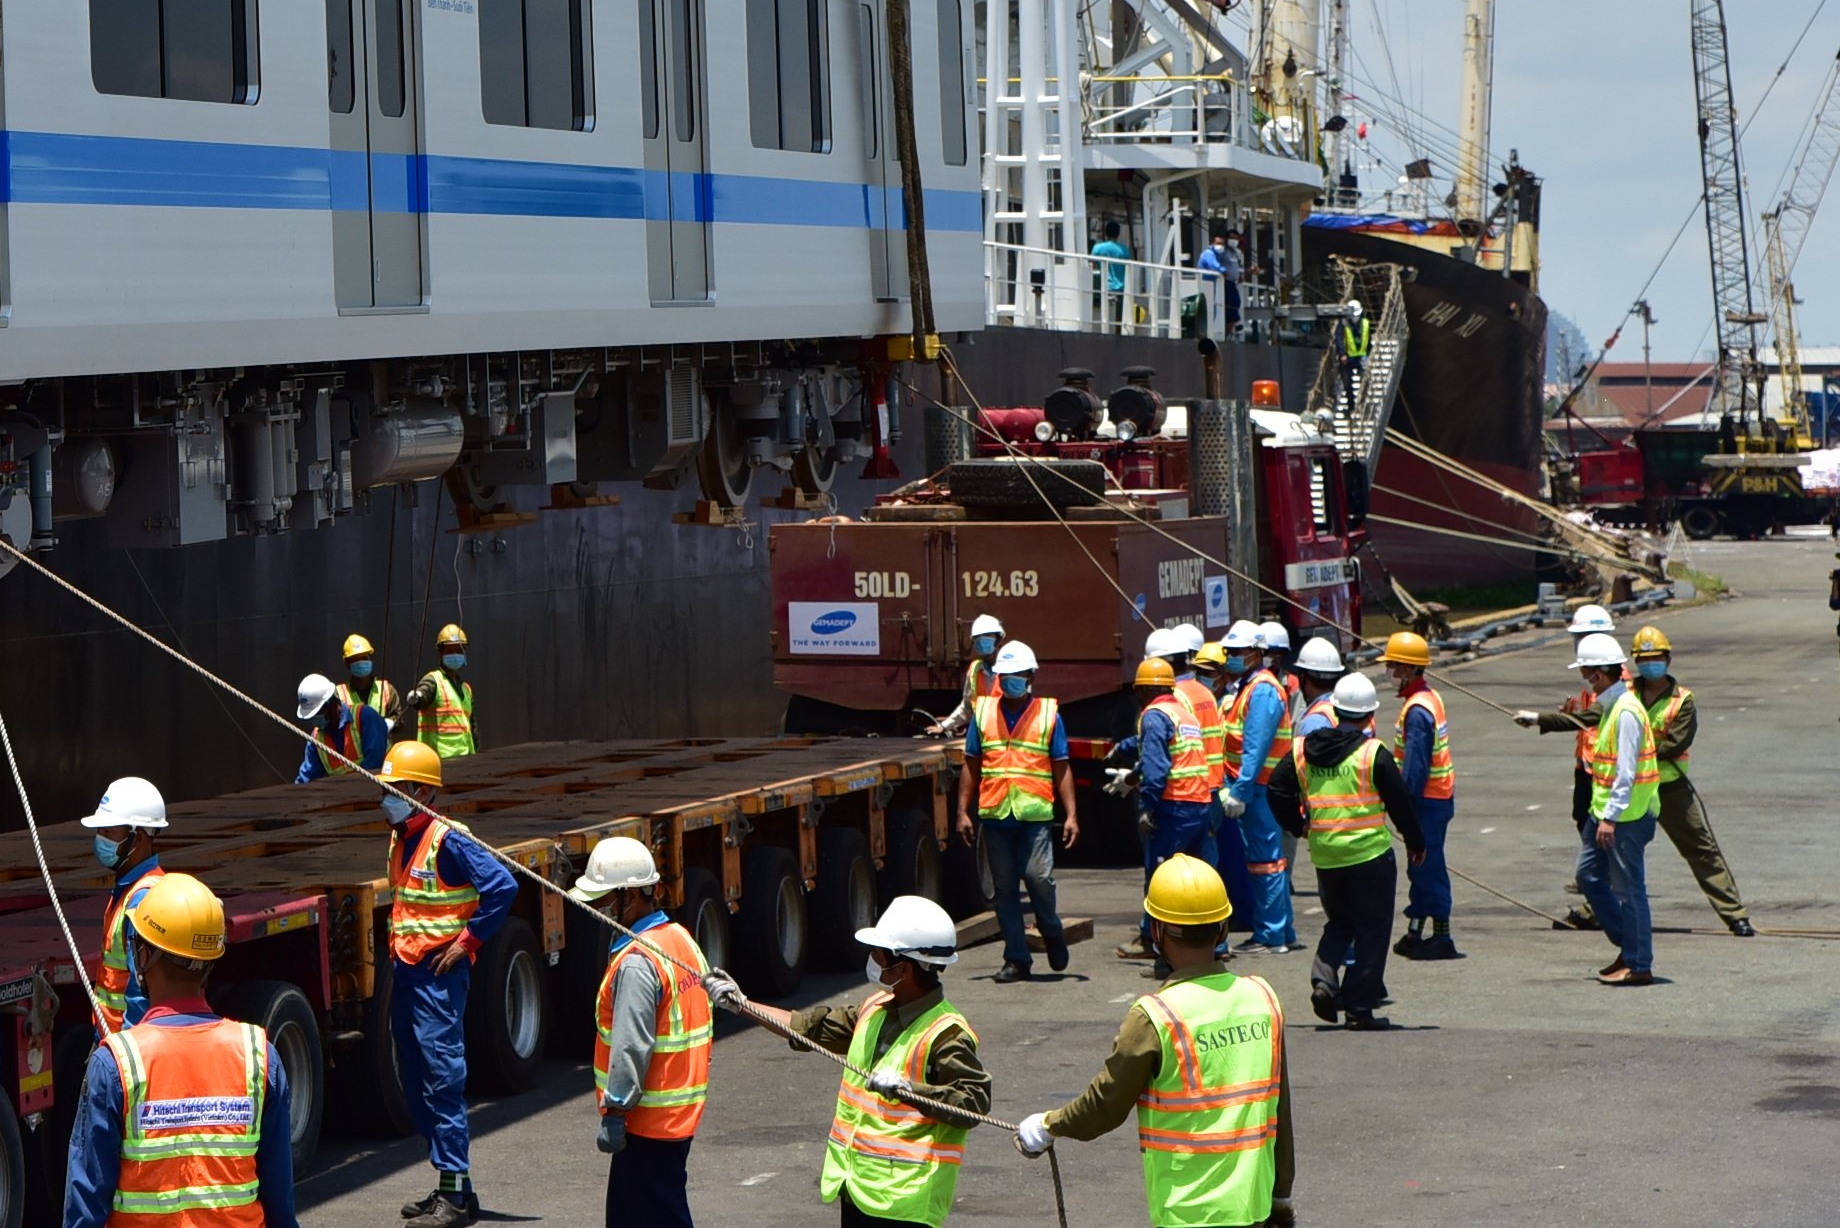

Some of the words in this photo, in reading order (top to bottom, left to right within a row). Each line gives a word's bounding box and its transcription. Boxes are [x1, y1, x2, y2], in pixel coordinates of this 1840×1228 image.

[1743, 476, 1778, 492] P&H
[962, 570, 1040, 598] 124.63
[1158, 557, 1205, 600] GEMADEPT
[813, 618, 855, 628] GEMADEPT
[793, 639, 809, 647] THE
[812, 639, 830, 647] WAY
[833, 639, 877, 648] FORWARD
[1196, 1020, 1269, 1053] SASTECO
[153, 1104, 180, 1116] Hitachi
[181, 1103, 218, 1115] Transport
[220, 1102, 250, 1114] System
